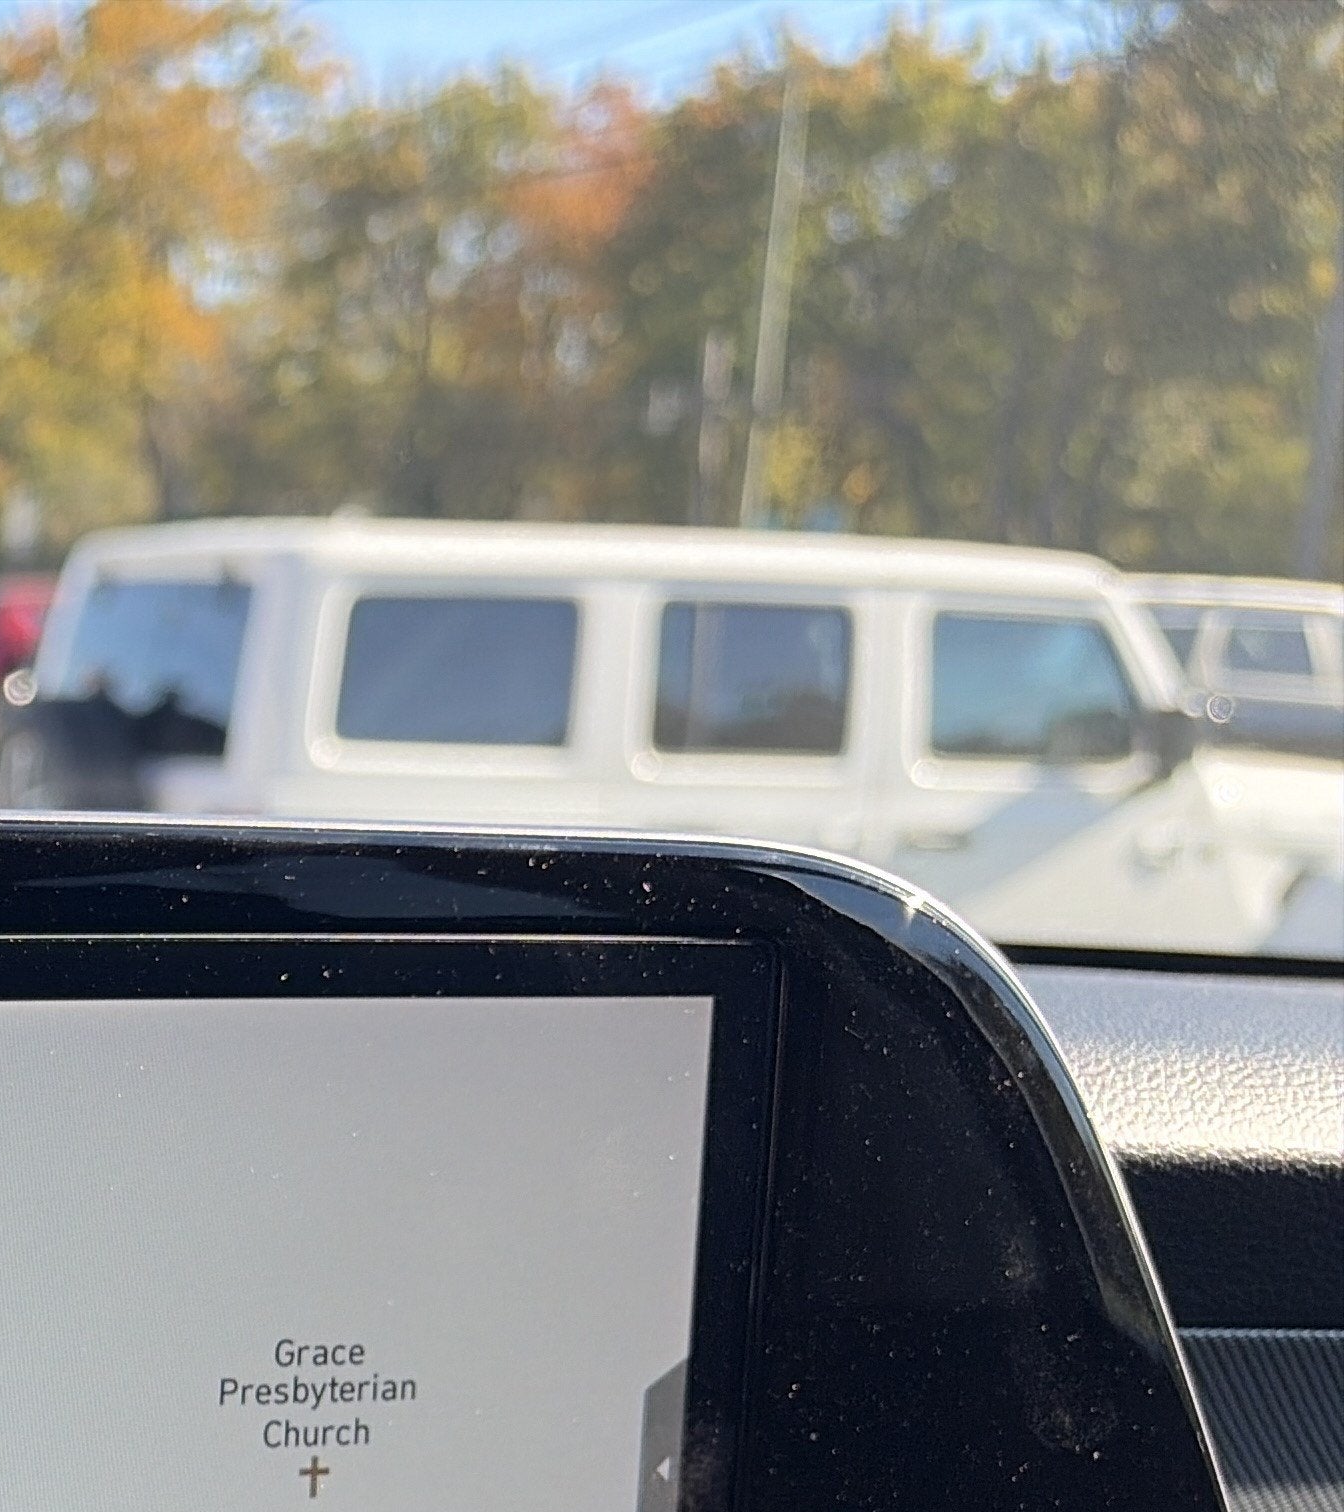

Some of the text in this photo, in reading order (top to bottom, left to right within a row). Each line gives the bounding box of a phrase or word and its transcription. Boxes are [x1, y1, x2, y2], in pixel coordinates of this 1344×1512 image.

[274, 1338, 366, 1368] Grace
[217, 1374, 417, 1410] Presbyterian
[262, 1417, 370, 1449] Church
